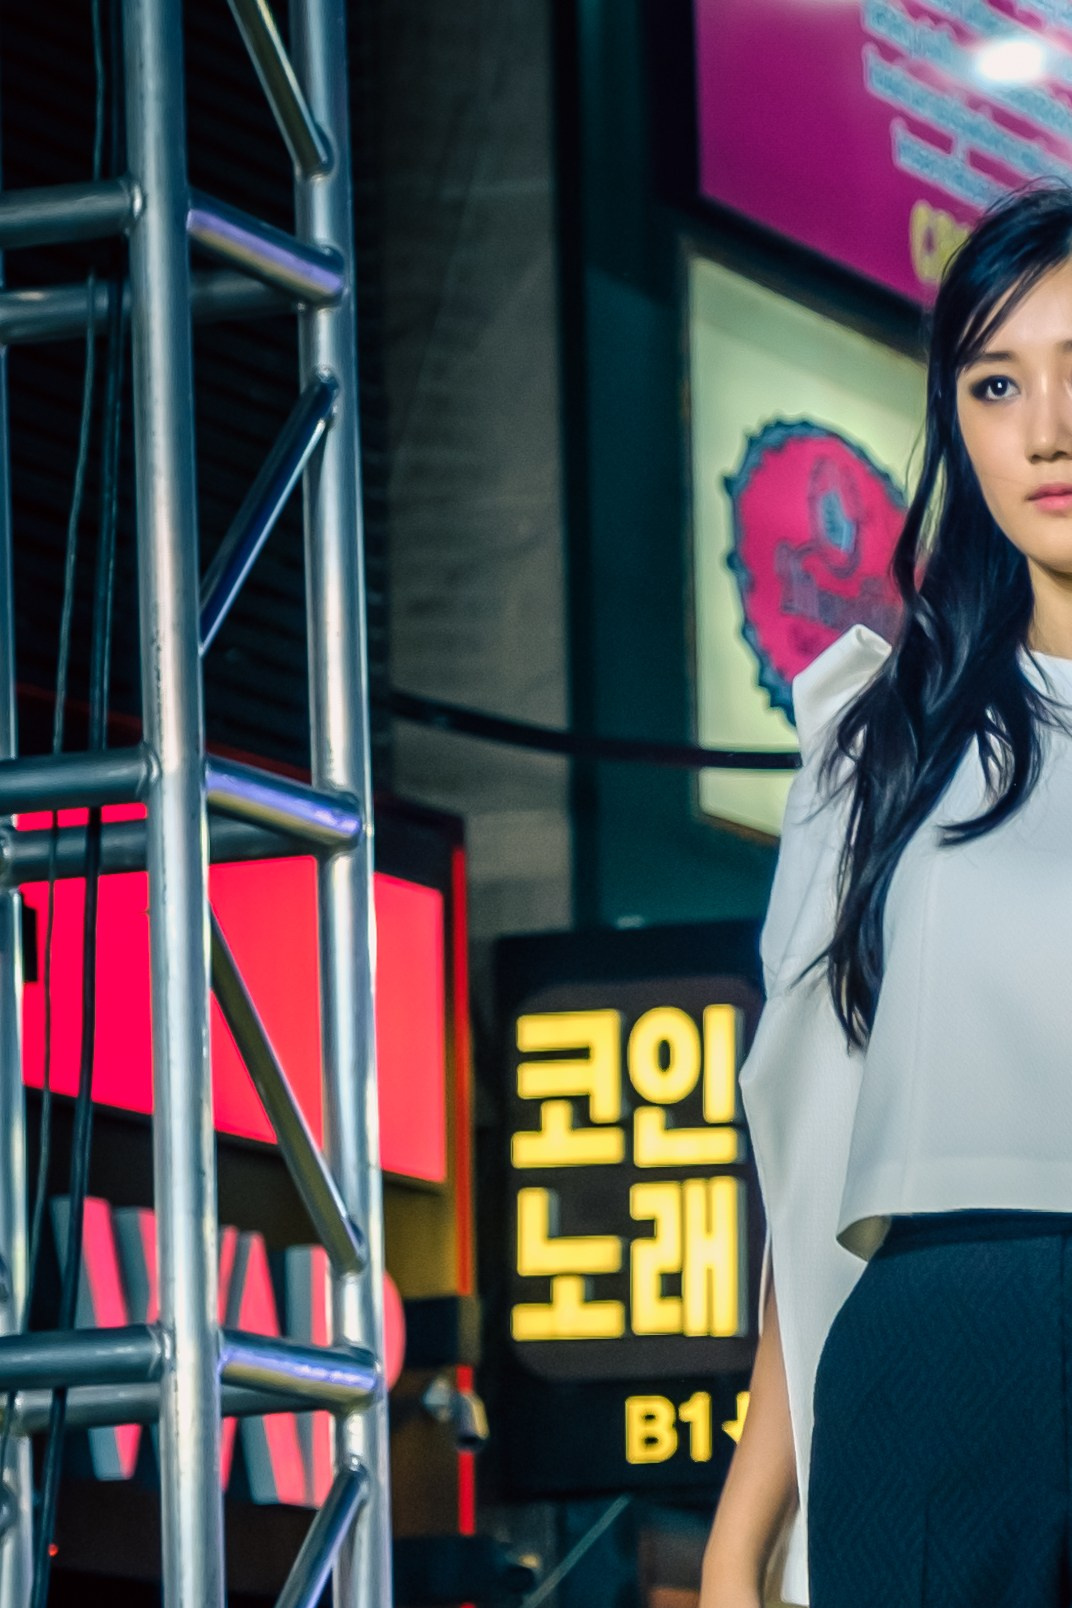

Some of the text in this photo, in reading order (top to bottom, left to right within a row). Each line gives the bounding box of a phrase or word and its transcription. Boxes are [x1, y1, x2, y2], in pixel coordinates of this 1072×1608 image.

[511, 1003, 738, 1168] 코인
[511, 1175, 739, 1341] 노래
[624, 1391, 712, 1464] B1
